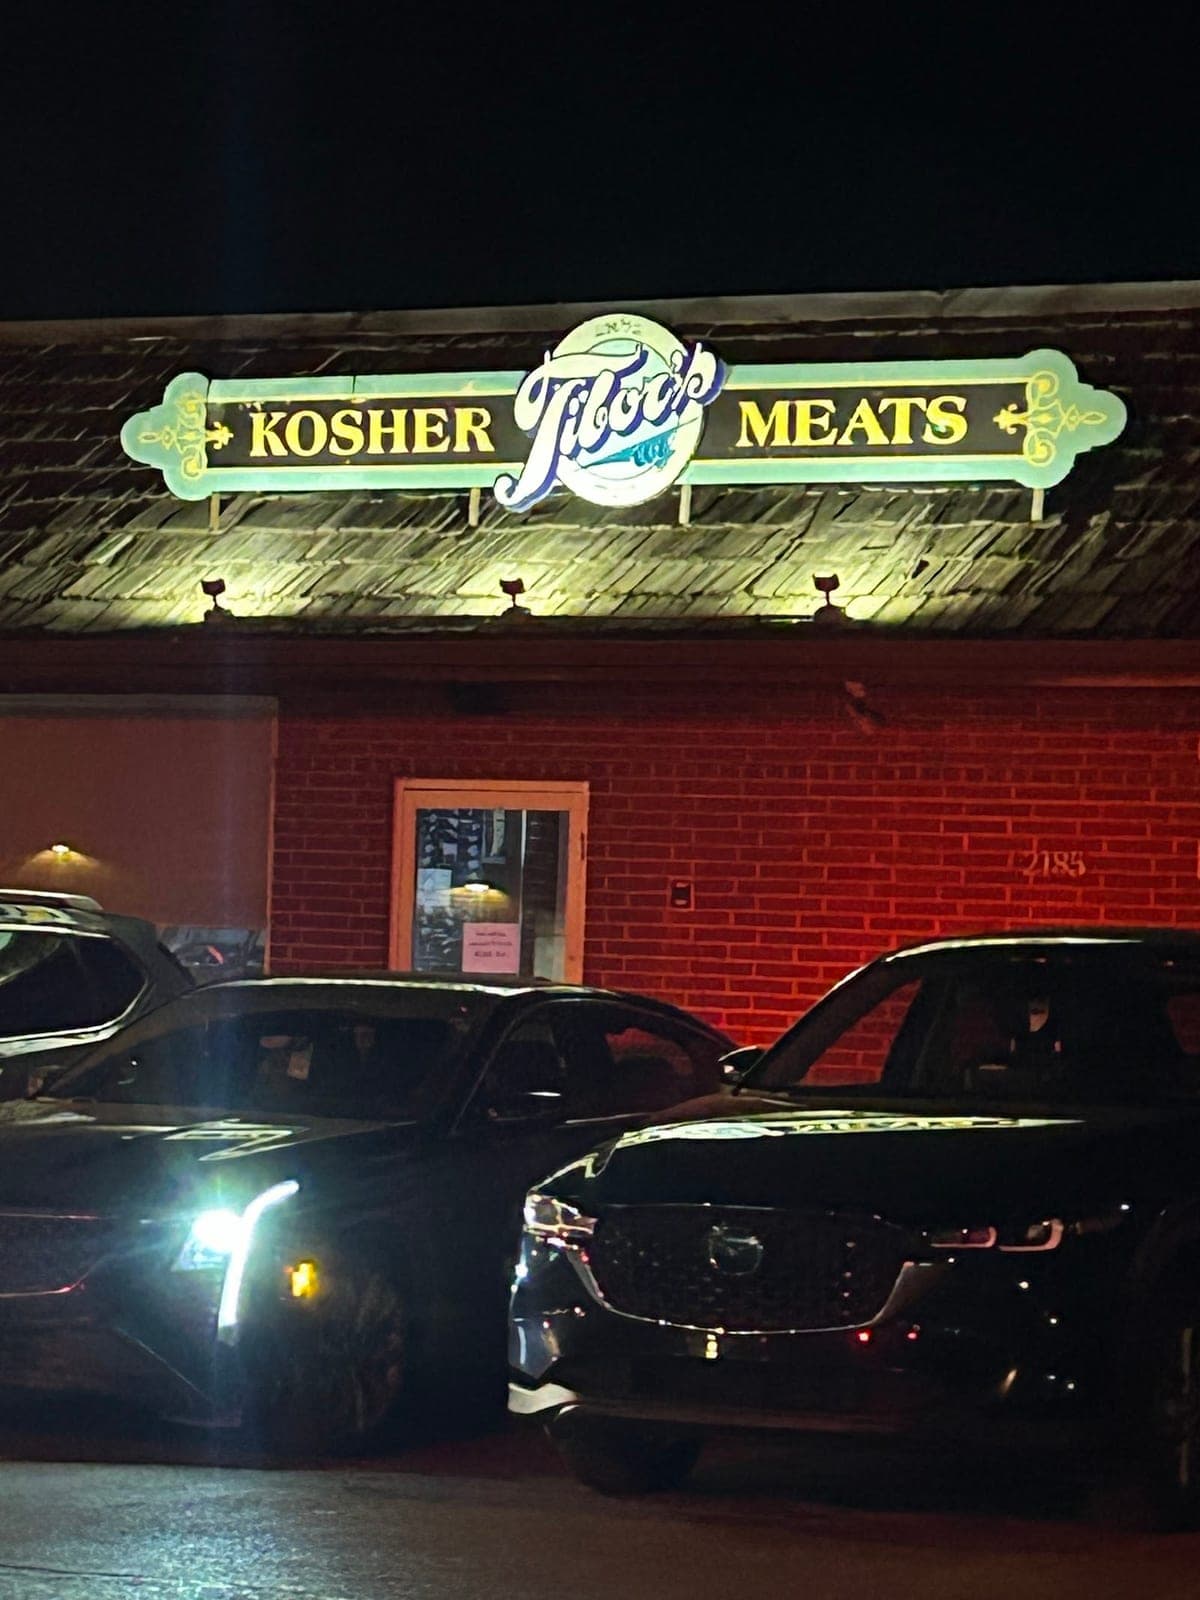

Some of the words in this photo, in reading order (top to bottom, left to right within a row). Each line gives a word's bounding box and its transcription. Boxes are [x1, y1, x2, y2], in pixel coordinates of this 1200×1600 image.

[249, 407, 496, 457] KOSHER
[735, 395, 968, 448] MEATS
[1022, 850, 1087, 878] 2185
